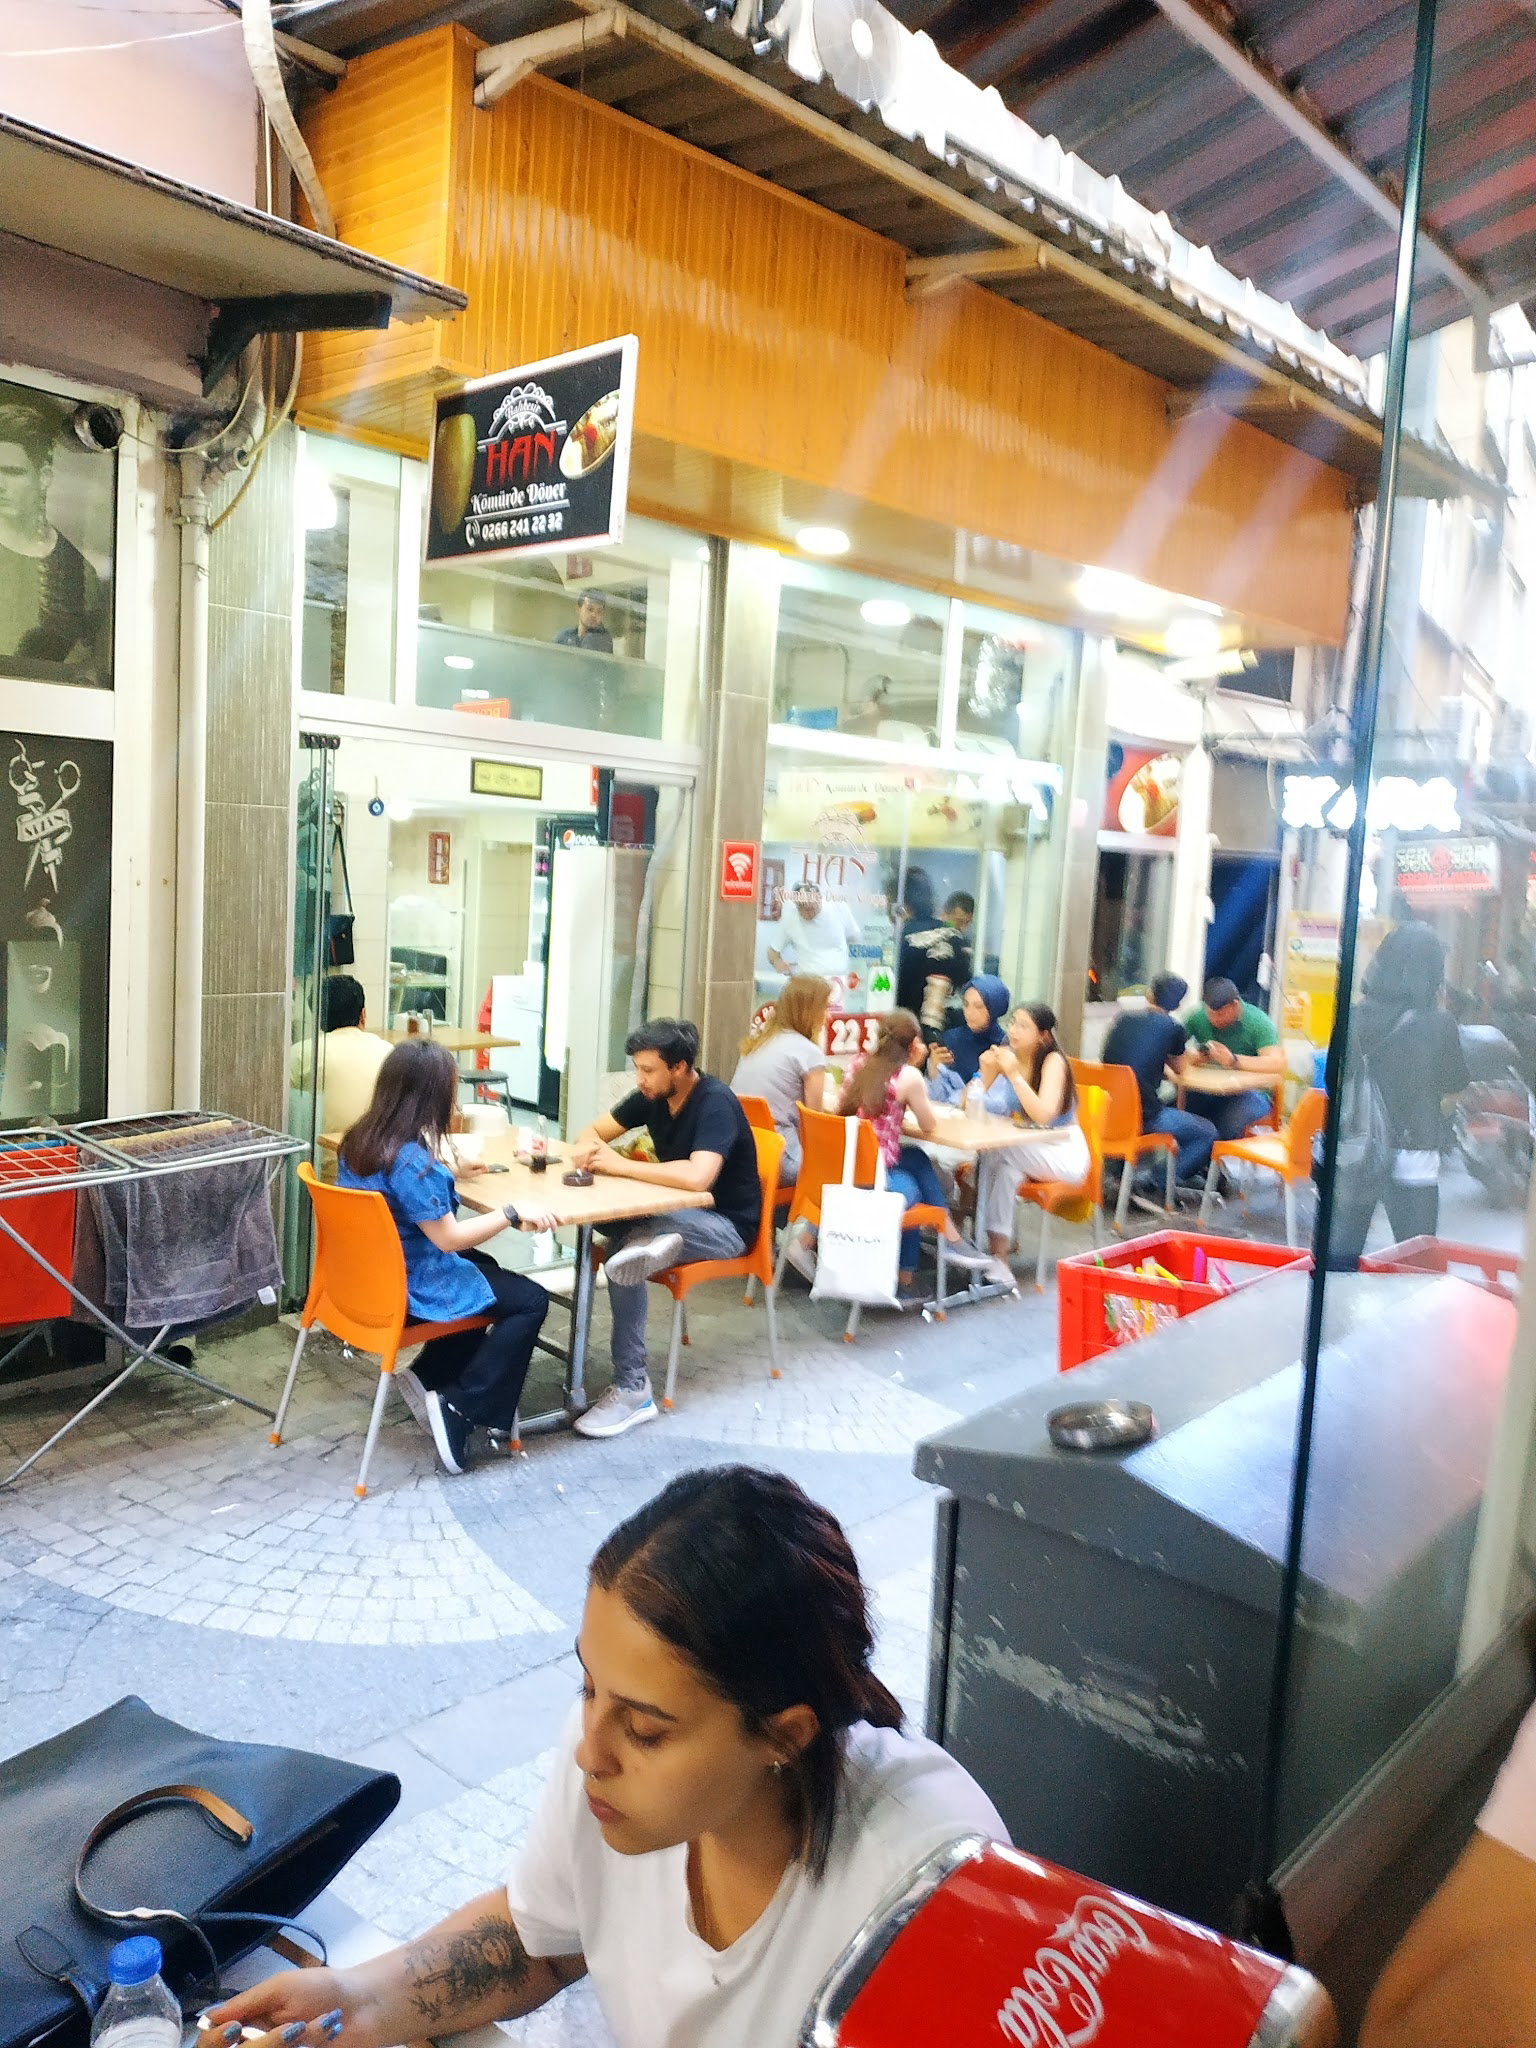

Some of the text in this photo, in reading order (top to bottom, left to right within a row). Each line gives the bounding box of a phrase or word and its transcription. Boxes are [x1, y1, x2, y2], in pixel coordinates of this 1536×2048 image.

[485, 429, 557, 487] HAN
[471, 481, 567, 514] Kömürde Döner
[482, 511, 563, 542] 0266 241 22 32
[830, 1018, 861, 1054] 22
[996, 1895, 1151, 2048] Coca-Cola
